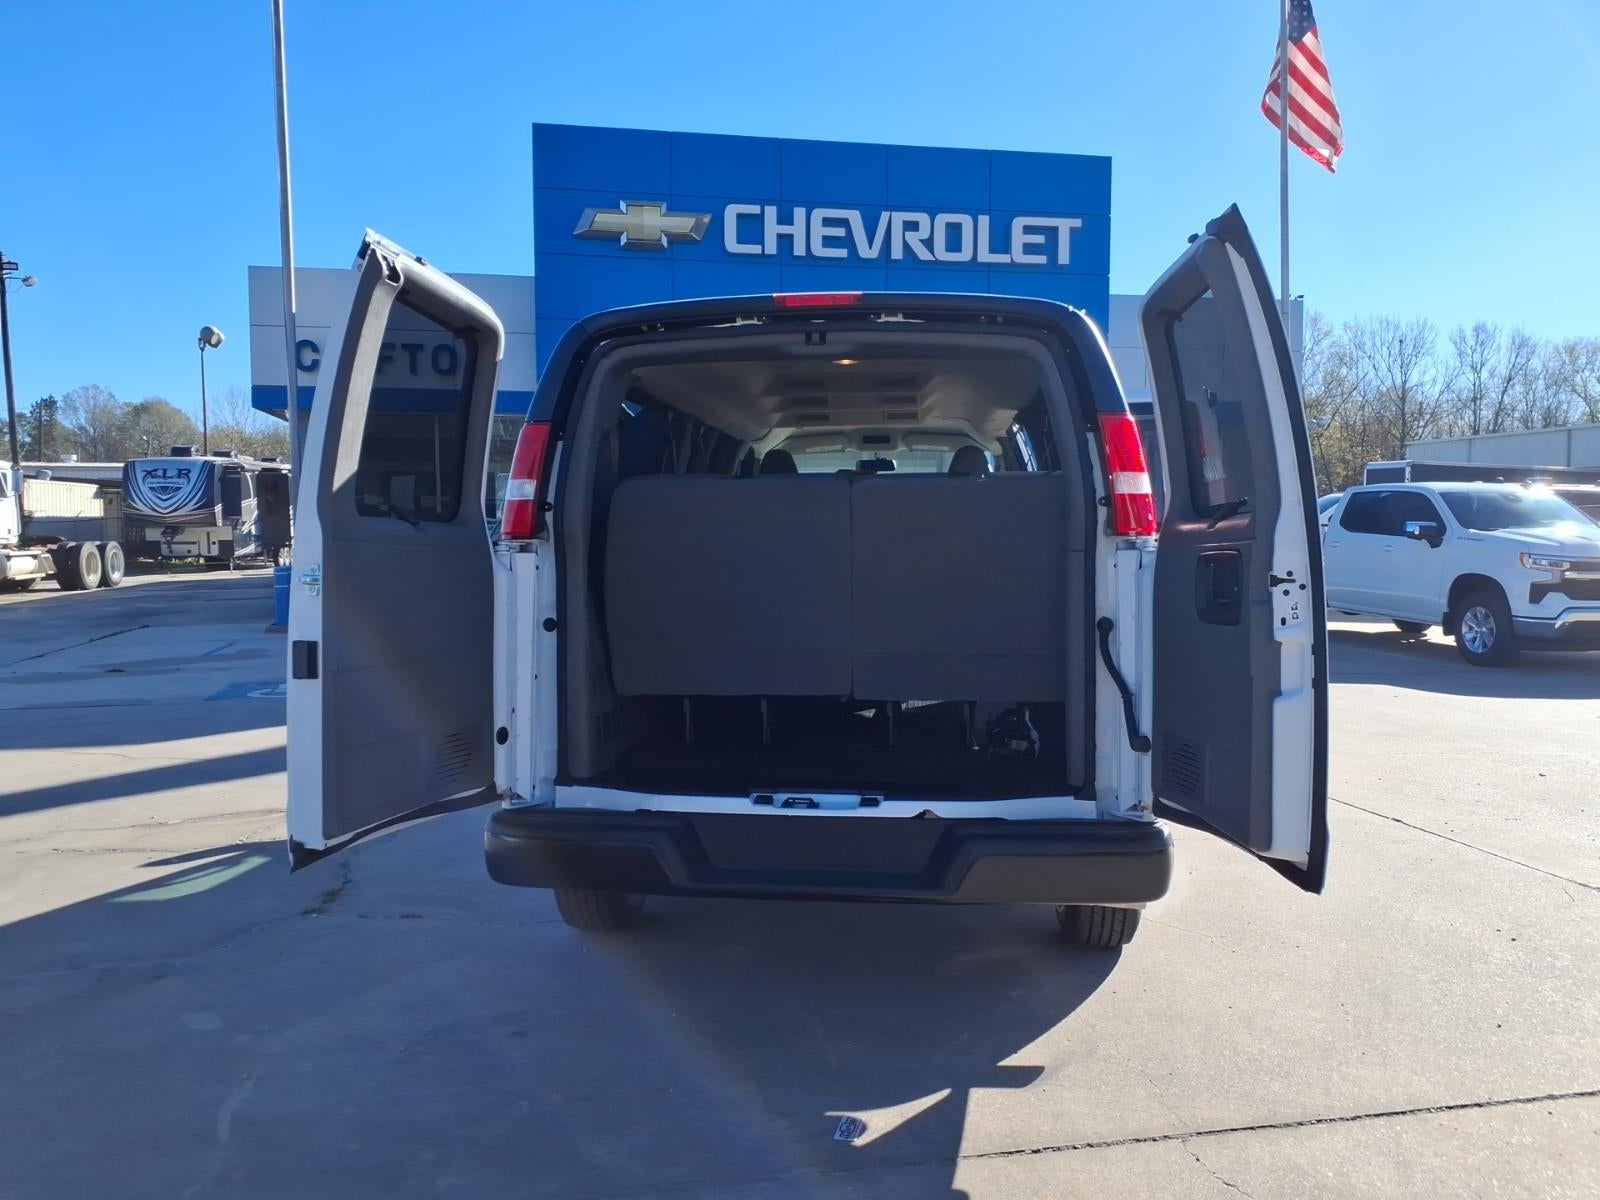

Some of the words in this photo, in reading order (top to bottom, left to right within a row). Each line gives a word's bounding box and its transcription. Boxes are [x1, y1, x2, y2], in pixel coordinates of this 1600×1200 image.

[723, 203, 1083, 266] CHEVROLET
[295, 339, 458, 376] CFTO
[141, 468, 192, 484] XLR
